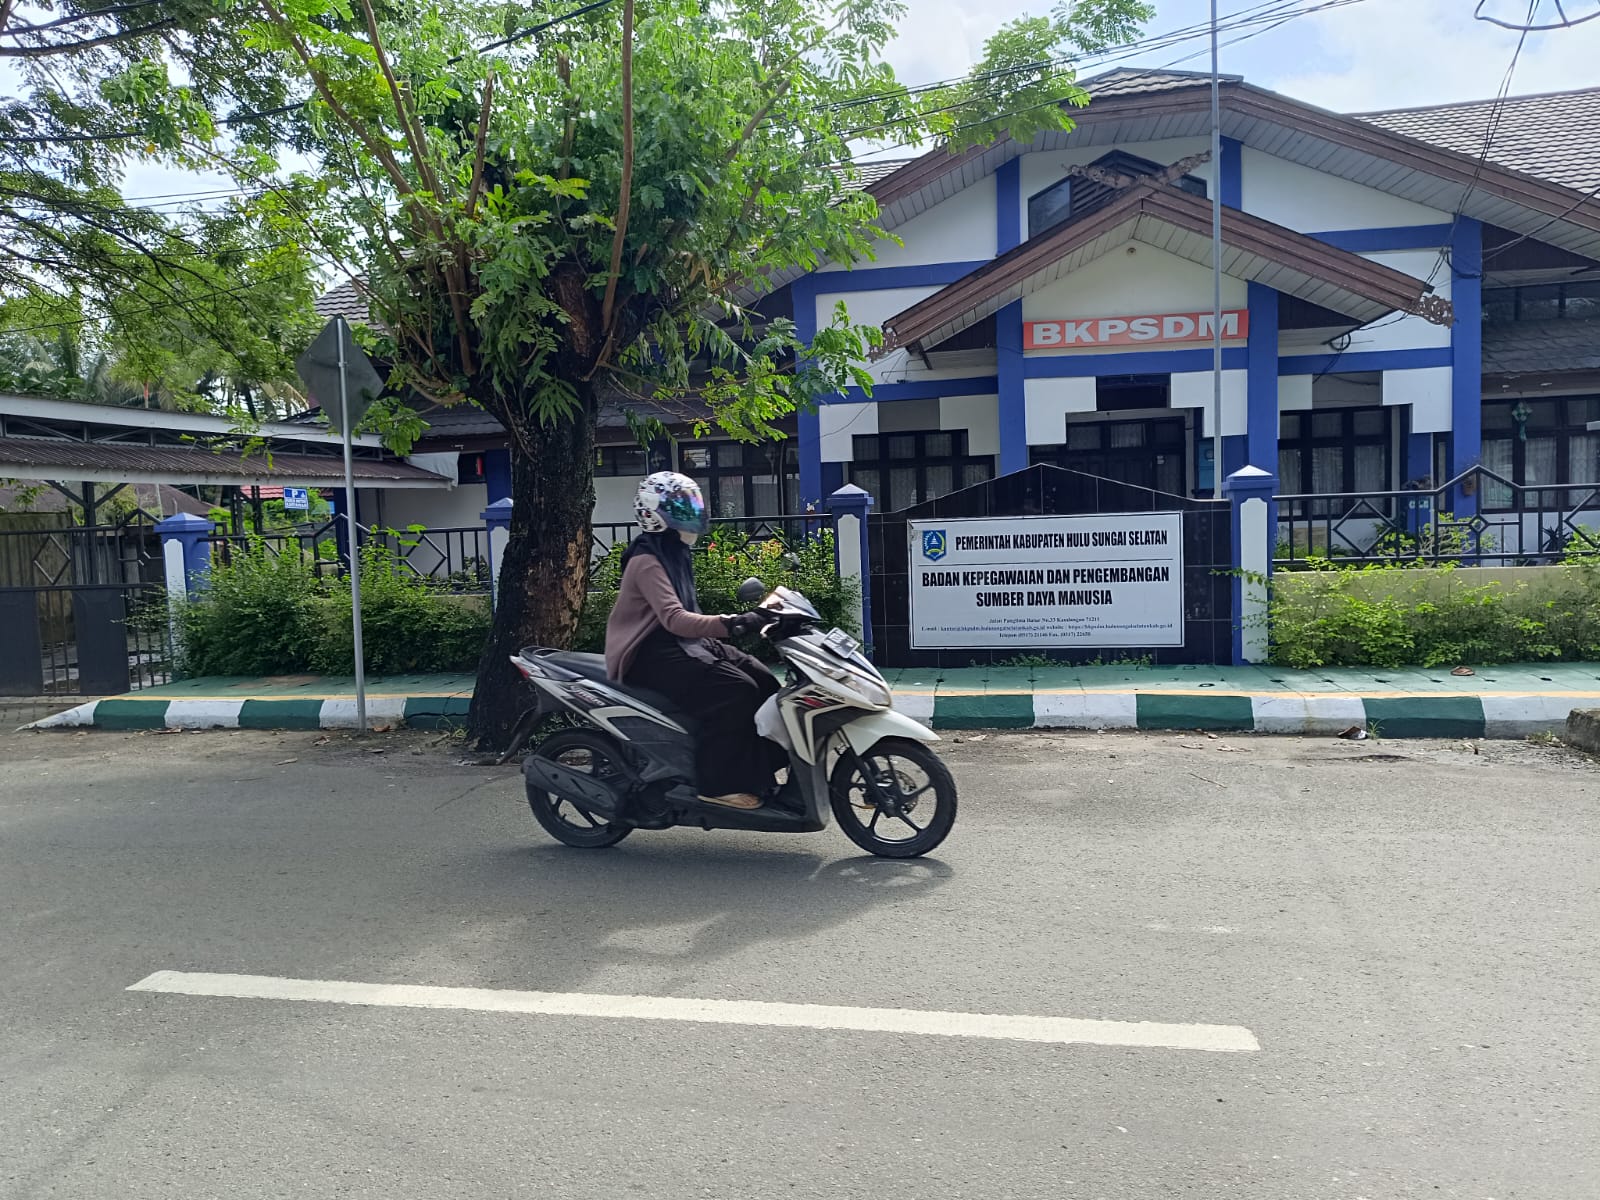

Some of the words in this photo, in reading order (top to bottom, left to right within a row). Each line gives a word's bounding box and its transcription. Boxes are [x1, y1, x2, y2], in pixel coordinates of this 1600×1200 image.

[1033, 313, 1239, 345] BKPSDM
[955, 535, 1011, 551] PEMERINTAH
[1013, 533, 1065, 549] KABUPATEN
[1066, 532, 1090, 548] HULU
[1092, 531, 1127, 547] SUNGAI
[1129, 530, 1168, 545] SELATAN
[922, 571, 960, 587] BADAN
[963, 569, 1044, 586] KEPEGAWAIAN
[1047, 568, 1070, 585] DAN
[1073, 566, 1169, 584] PENGEMBANGAN
[976, 591, 1024, 607] SUMBER
[1027, 590, 1056, 606] DAYA
[1058, 589, 1113, 606] MANUSIA
